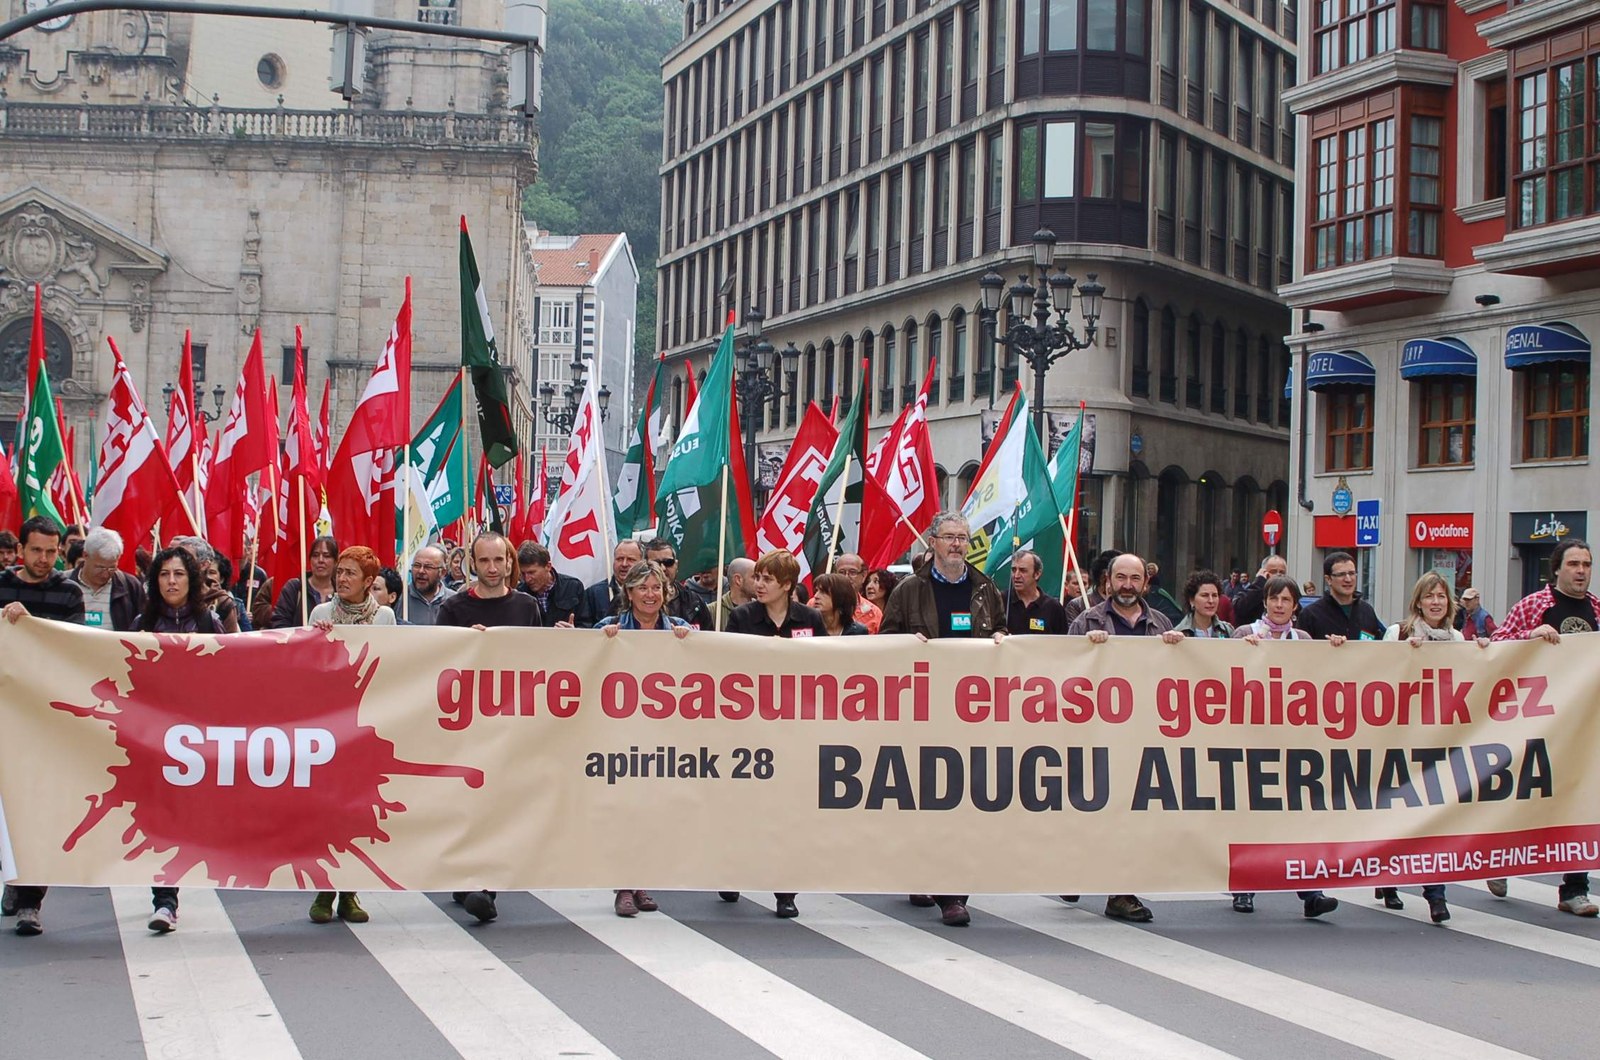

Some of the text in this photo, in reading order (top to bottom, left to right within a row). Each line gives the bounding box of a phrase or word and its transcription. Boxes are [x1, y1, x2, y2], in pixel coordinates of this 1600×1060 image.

[1358, 515, 1379, 530] TAXI
[1429, 523, 1469, 538] vodafone
[953, 616, 971, 626] ELA
[436, 661, 1555, 740] gure osasunari eraso gehiagorik ez
[162, 723, 336, 788] STOP
[584, 745, 775, 785] apirilak 28
[818, 737, 1553, 812] BADUGU ALTERNATIBA
